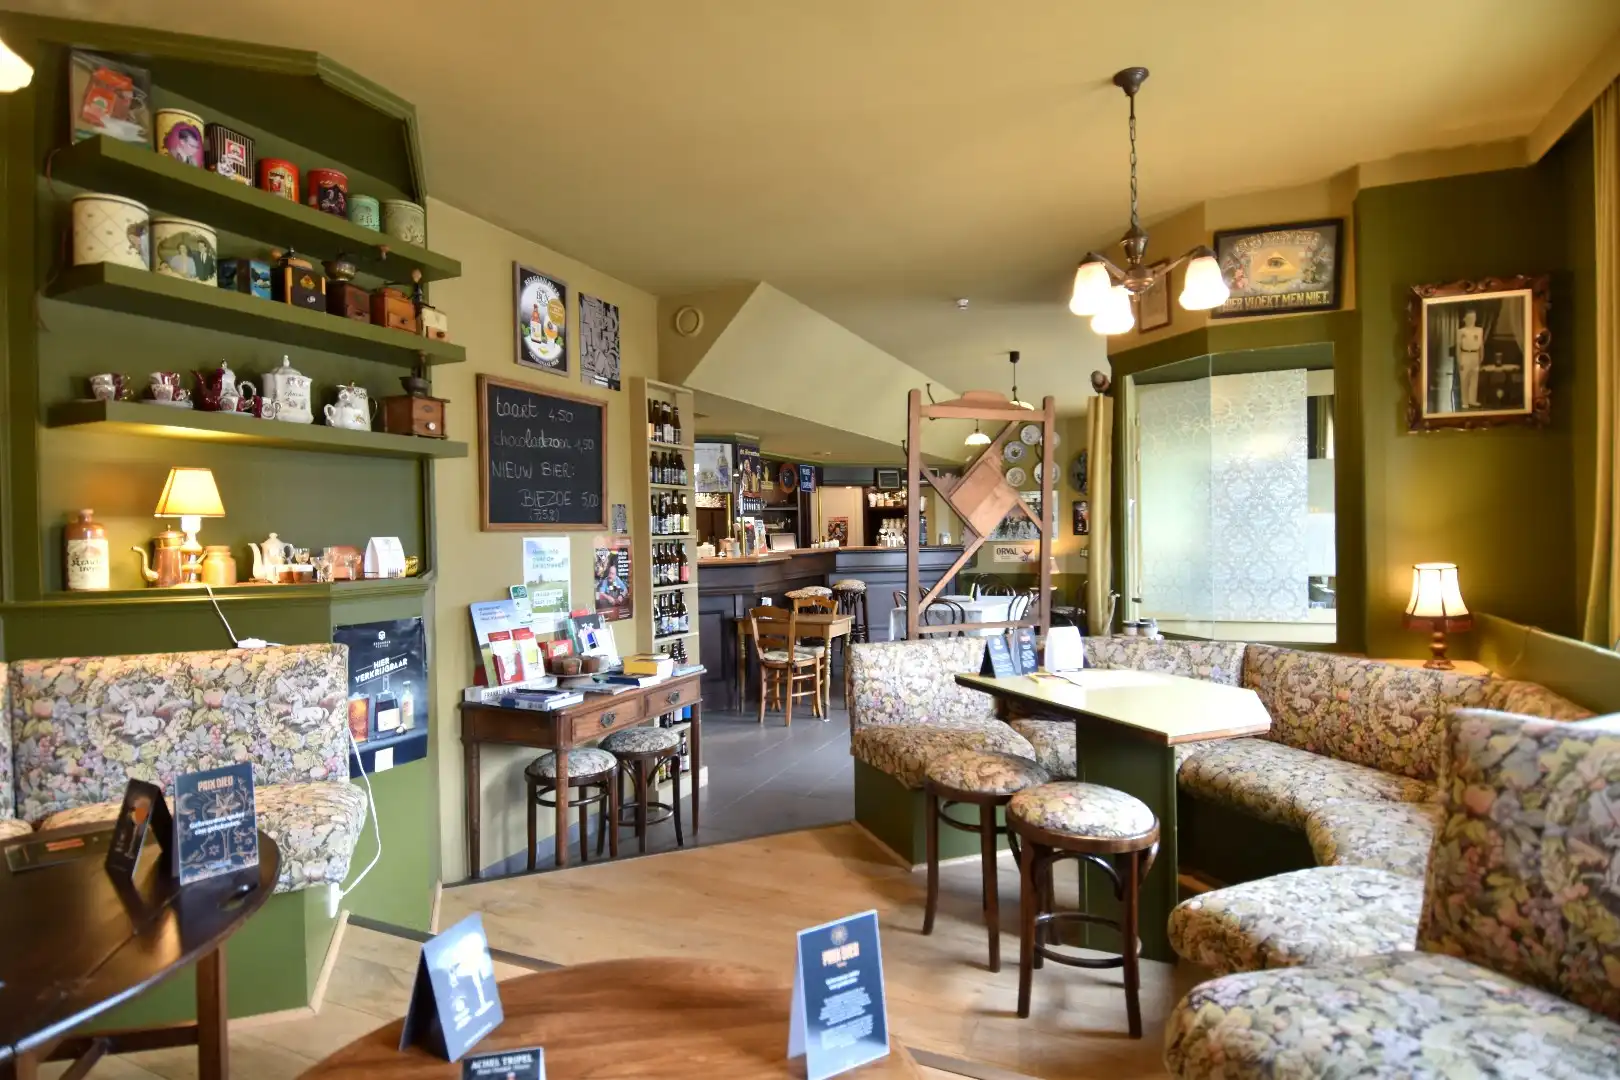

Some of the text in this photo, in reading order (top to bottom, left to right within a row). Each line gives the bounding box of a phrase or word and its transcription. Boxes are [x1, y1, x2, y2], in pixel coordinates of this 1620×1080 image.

[1245, 294, 1281, 309] VLOEKT
[1282, 292, 1305, 306] MEN
[1305, 290, 1330, 304] NIET.
[496, 396, 539, 418] taart
[492, 461, 533, 479] NIEUW
[996, 547, 1019, 556] ORVAL
[355, 658, 408, 683] VERKRIJGBAAR
[373, 657, 390, 669] HIER
